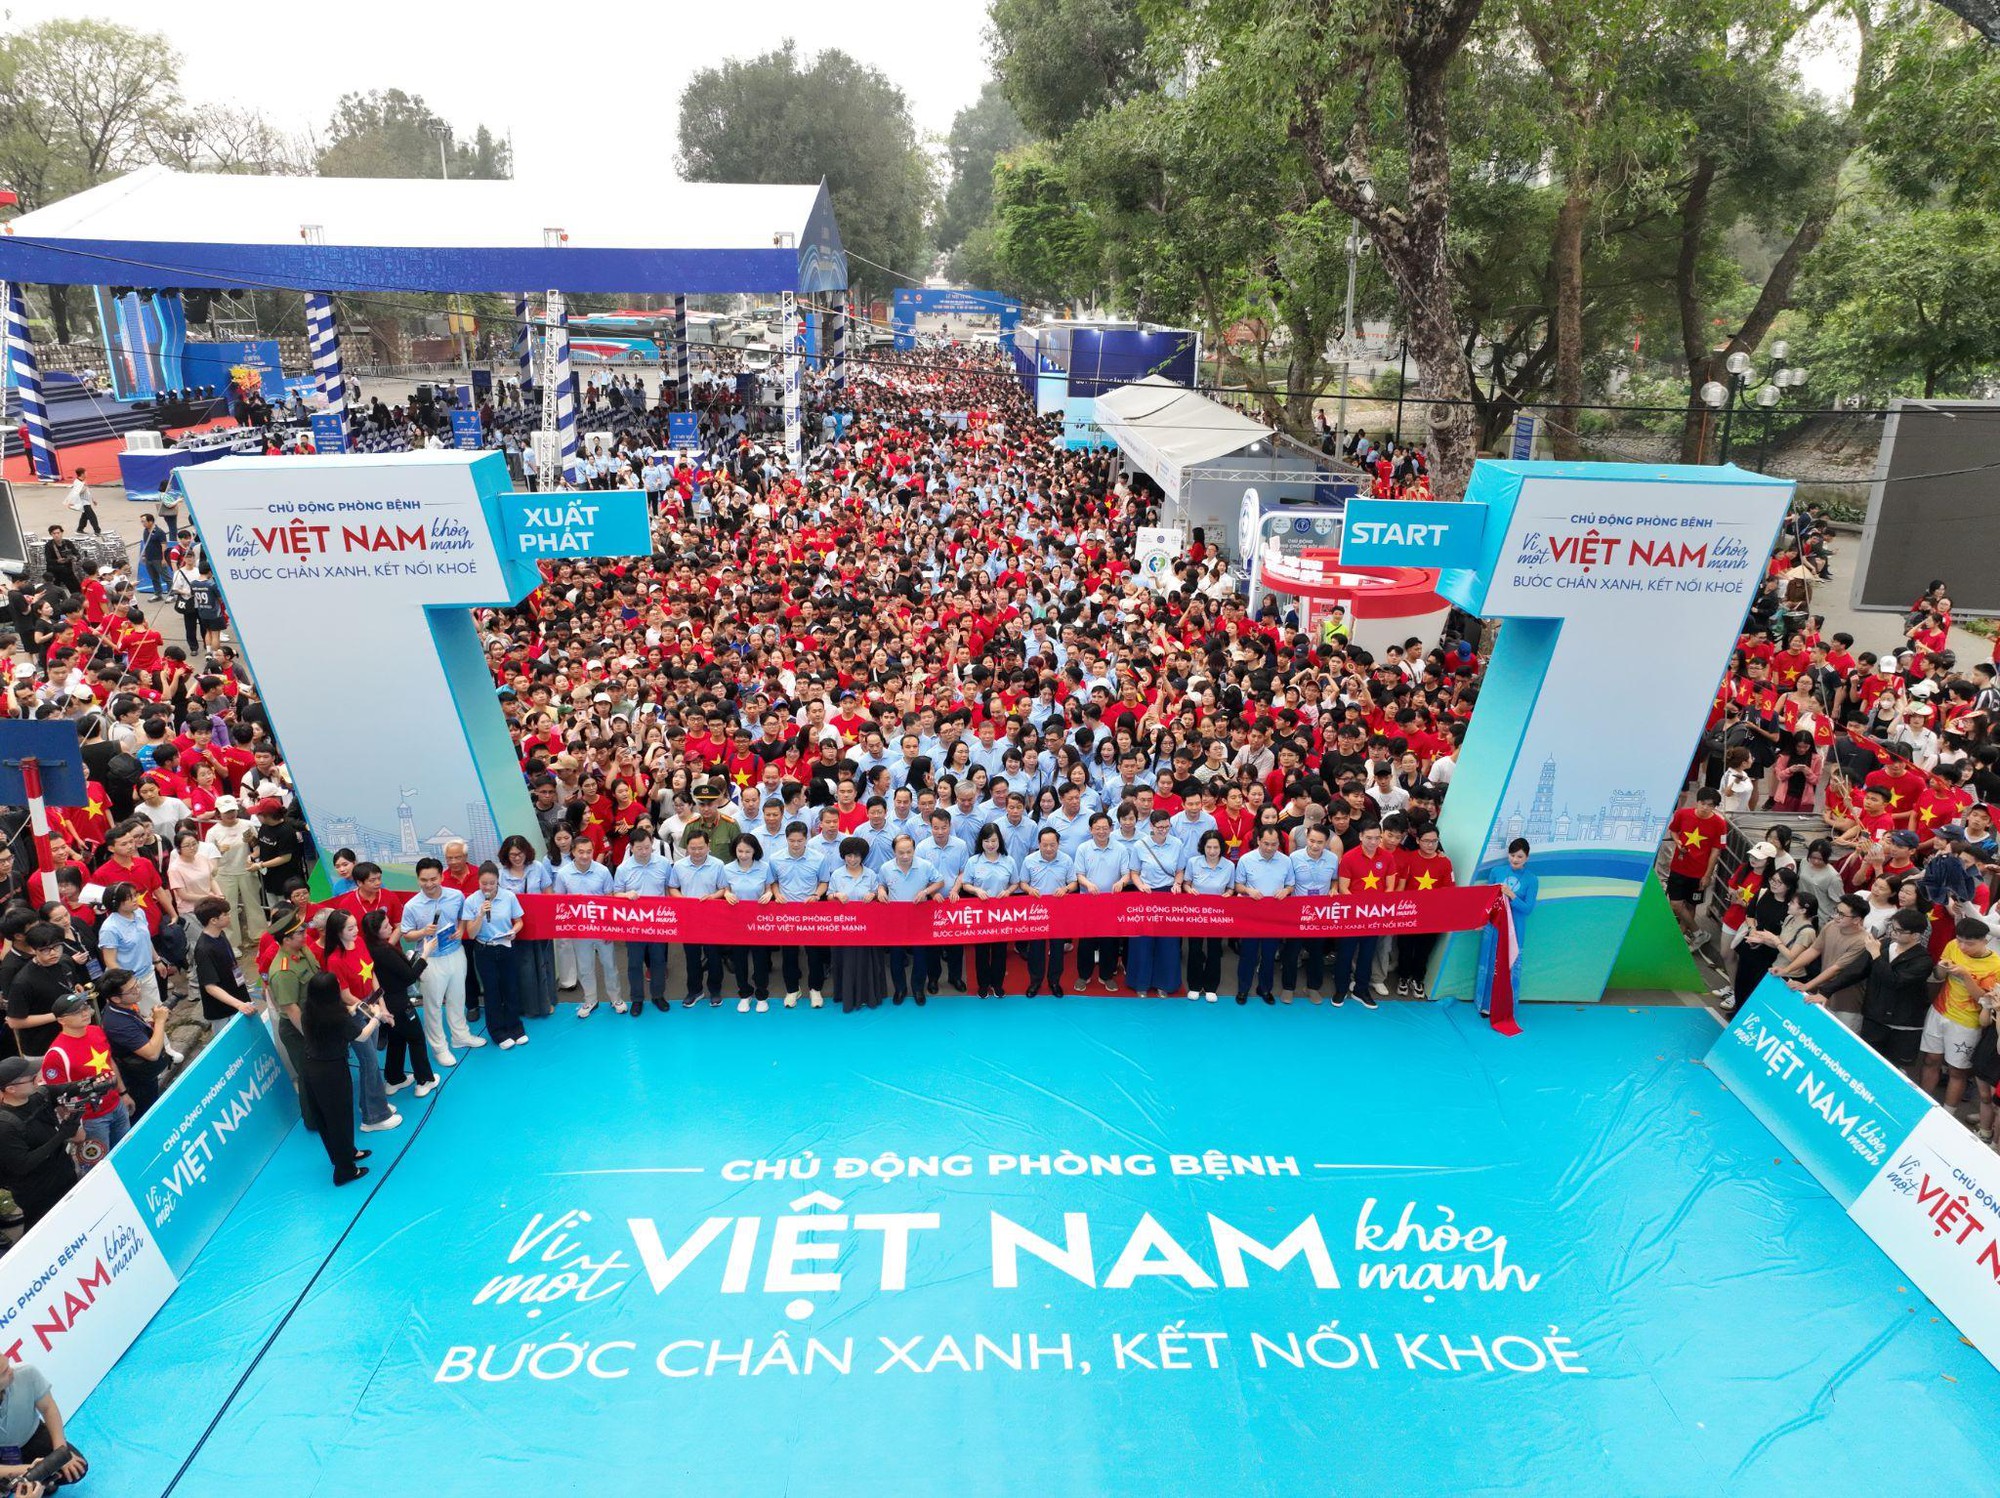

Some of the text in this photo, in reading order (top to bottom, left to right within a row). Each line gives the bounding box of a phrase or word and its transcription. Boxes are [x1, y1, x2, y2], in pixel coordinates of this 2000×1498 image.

[268, 498, 421, 514] CHỦ ĐỘNG PHÒNG BỆNH
[523, 499, 599, 527] XUẤT
[1351, 522, 1449, 547] START
[1570, 512, 1713, 530] CHỦ ĐỘNG PHÒNG BỆNH
[226, 517, 474, 562] Vì một VIỆT NAM khỏe mạnh
[519, 527, 594, 552] PHÁT
[1517, 529, 1749, 573] Vì một VIỆT NAM khỏe mạnh
[230, 565, 274, 580] BƯỚC
[276, 562, 320, 579] CHÂN
[375, 562, 400, 576] KẾT
[404, 561, 432, 575] NỐI
[1513, 573, 1553, 588] BƯỚC
[1557, 575, 1598, 590] CHÂN
[1600, 578, 1644, 591] XANH,
[1647, 576, 1671, 591] KẾT
[1676, 578, 1701, 592] NỐI
[569, 900, 608, 923] VIỆT
[612, 906, 655, 923] NAM
[757, 913, 857, 923] CHỦ ĐỘNG PHÒNG BỆNH
[946, 906, 983, 929] VIỆT
[988, 908, 1028, 923] NAM
[1117, 914, 1126, 923] VÌ
[1127, 914, 1145, 923] MỘT
[1146, 914, 1163, 924] VIỆT
[1165, 915, 1184, 923] NAM
[1126, 905, 1144, 914] CHỦ
[1145, 905, 1170, 915] ĐỘNG
[1172, 905, 1201, 914] PHÒNG
[1314, 902, 1352, 924] VIỆT
[1355, 904, 1396, 919] NAM
[555, 923, 577, 932] BƯỚC
[577, 924, 600, 932] CHÂN
[626, 924, 640, 934] KẾT
[641, 925, 656, 935] NỐI
[747, 923, 756, 932] VÌ
[757, 924, 776, 932] MỘT
[776, 923, 795, 932] VIỆT
[796, 924, 816, 932] NAM
[933, 929, 954, 938] BƯỚC
[954, 928, 976, 937] CHÂN
[1000, 925, 1013, 935] KẾT
[1015, 925, 1029, 933] NỐI
[1782, 1018, 1876, 1105] CHỦ ĐỘNG PHÒNG BỆNH
[261, 1066, 282, 1095] mạnh
[1733, 1012, 1888, 1167] Vì một VIỆT NAM khỏe mạnh
[162, 1057, 245, 1153] CHỦ ĐỘNG PHÒNG BỆNH
[211, 1076, 263, 1146] NAM
[161, 1129, 214, 1197] VIỆT
[721, 1149, 1300, 1184] CHỦ ĐỘNG PHÒNG BỆNH
[1898, 1155, 1921, 1176] Vì
[1886, 1171, 1920, 1196] một
[1952, 1168, 1977, 1190] CHỦ
[145, 1185, 162, 1214] Vì
[155, 1190, 177, 1229] một
[1917, 1173, 1985, 1246] VIỆT
[104, 1224, 136, 1263] khỏe
[111, 1237, 144, 1278] mạnh
[471, 1189, 1541, 1321] Vì một VIỆT NAM khỏe mạnh
[17, 1263, 59, 1309] PHÒNG
[57, 1232, 88, 1267] BỆNH
[32, 1255, 112, 1353] NAM
[434, 1319, 1590, 1383] BƯỚC CHÂN XANH, KẾT NỐI KHOẺ
